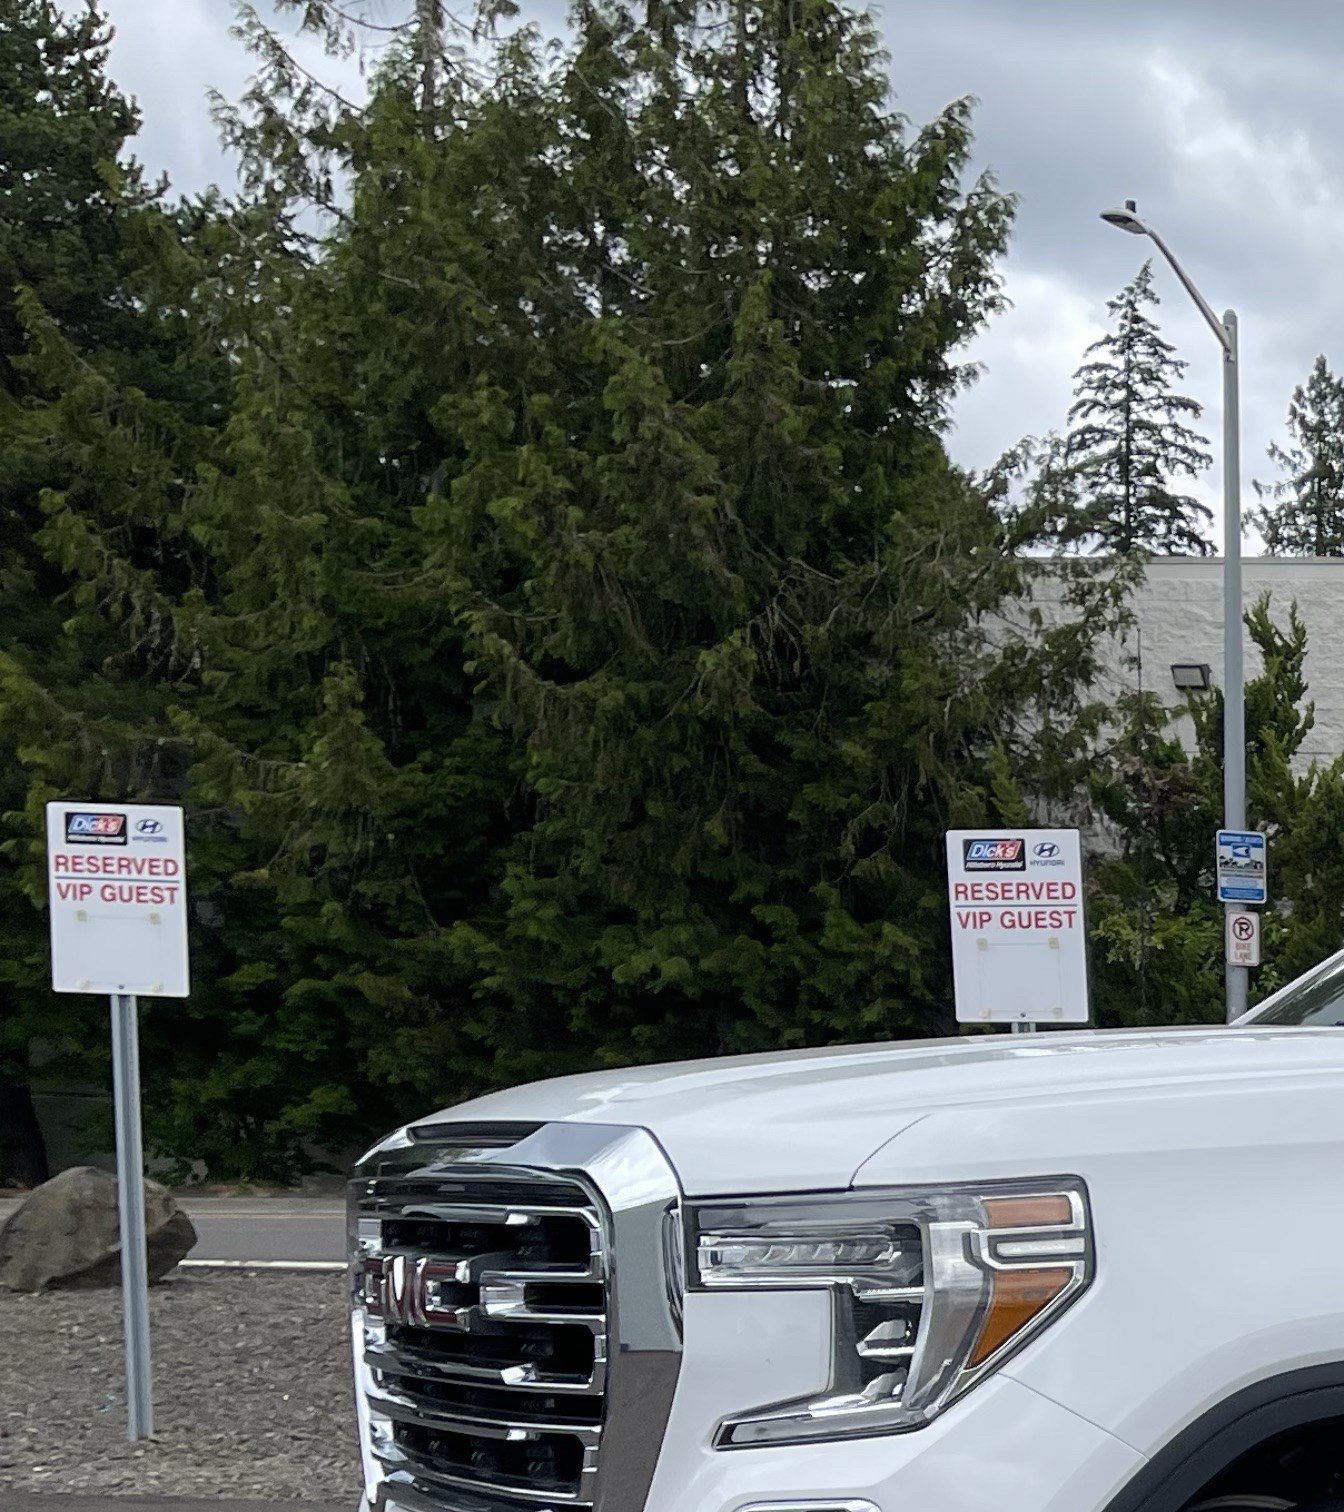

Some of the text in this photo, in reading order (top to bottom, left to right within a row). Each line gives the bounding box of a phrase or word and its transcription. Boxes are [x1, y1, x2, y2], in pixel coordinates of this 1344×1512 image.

[54, 854, 179, 877] RESERVED
[56, 882, 180, 905] VIP GUEST
[953, 881, 1077, 901] RESERVED
[956, 910, 1077, 930] VIP GUEST
